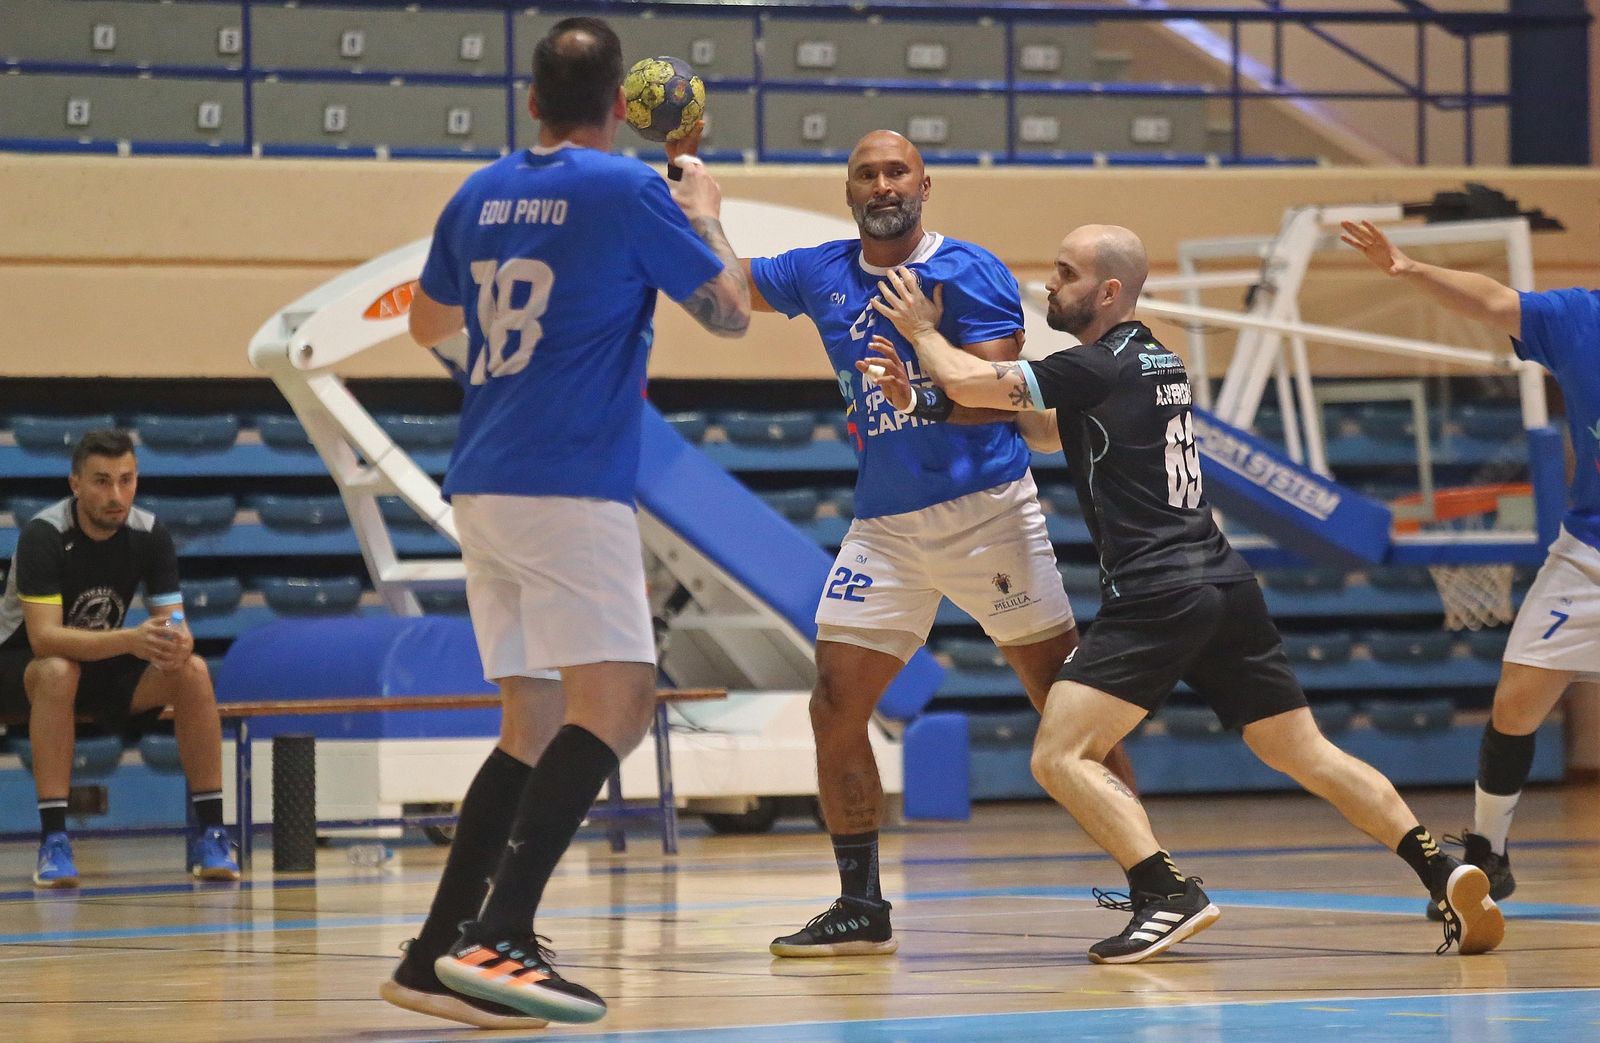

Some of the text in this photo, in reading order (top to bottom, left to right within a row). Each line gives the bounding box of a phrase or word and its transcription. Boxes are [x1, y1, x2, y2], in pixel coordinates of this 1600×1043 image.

[478, 199, 568, 225] EDU PAVO
[469, 258, 556, 386] 18
[1164, 410, 1203, 509] 69
[1244, 450, 1343, 515] SYSTEM
[826, 566, 874, 603] 22
[993, 594, 1031, 611] MELILLA
[1541, 610, 1570, 640] 7
